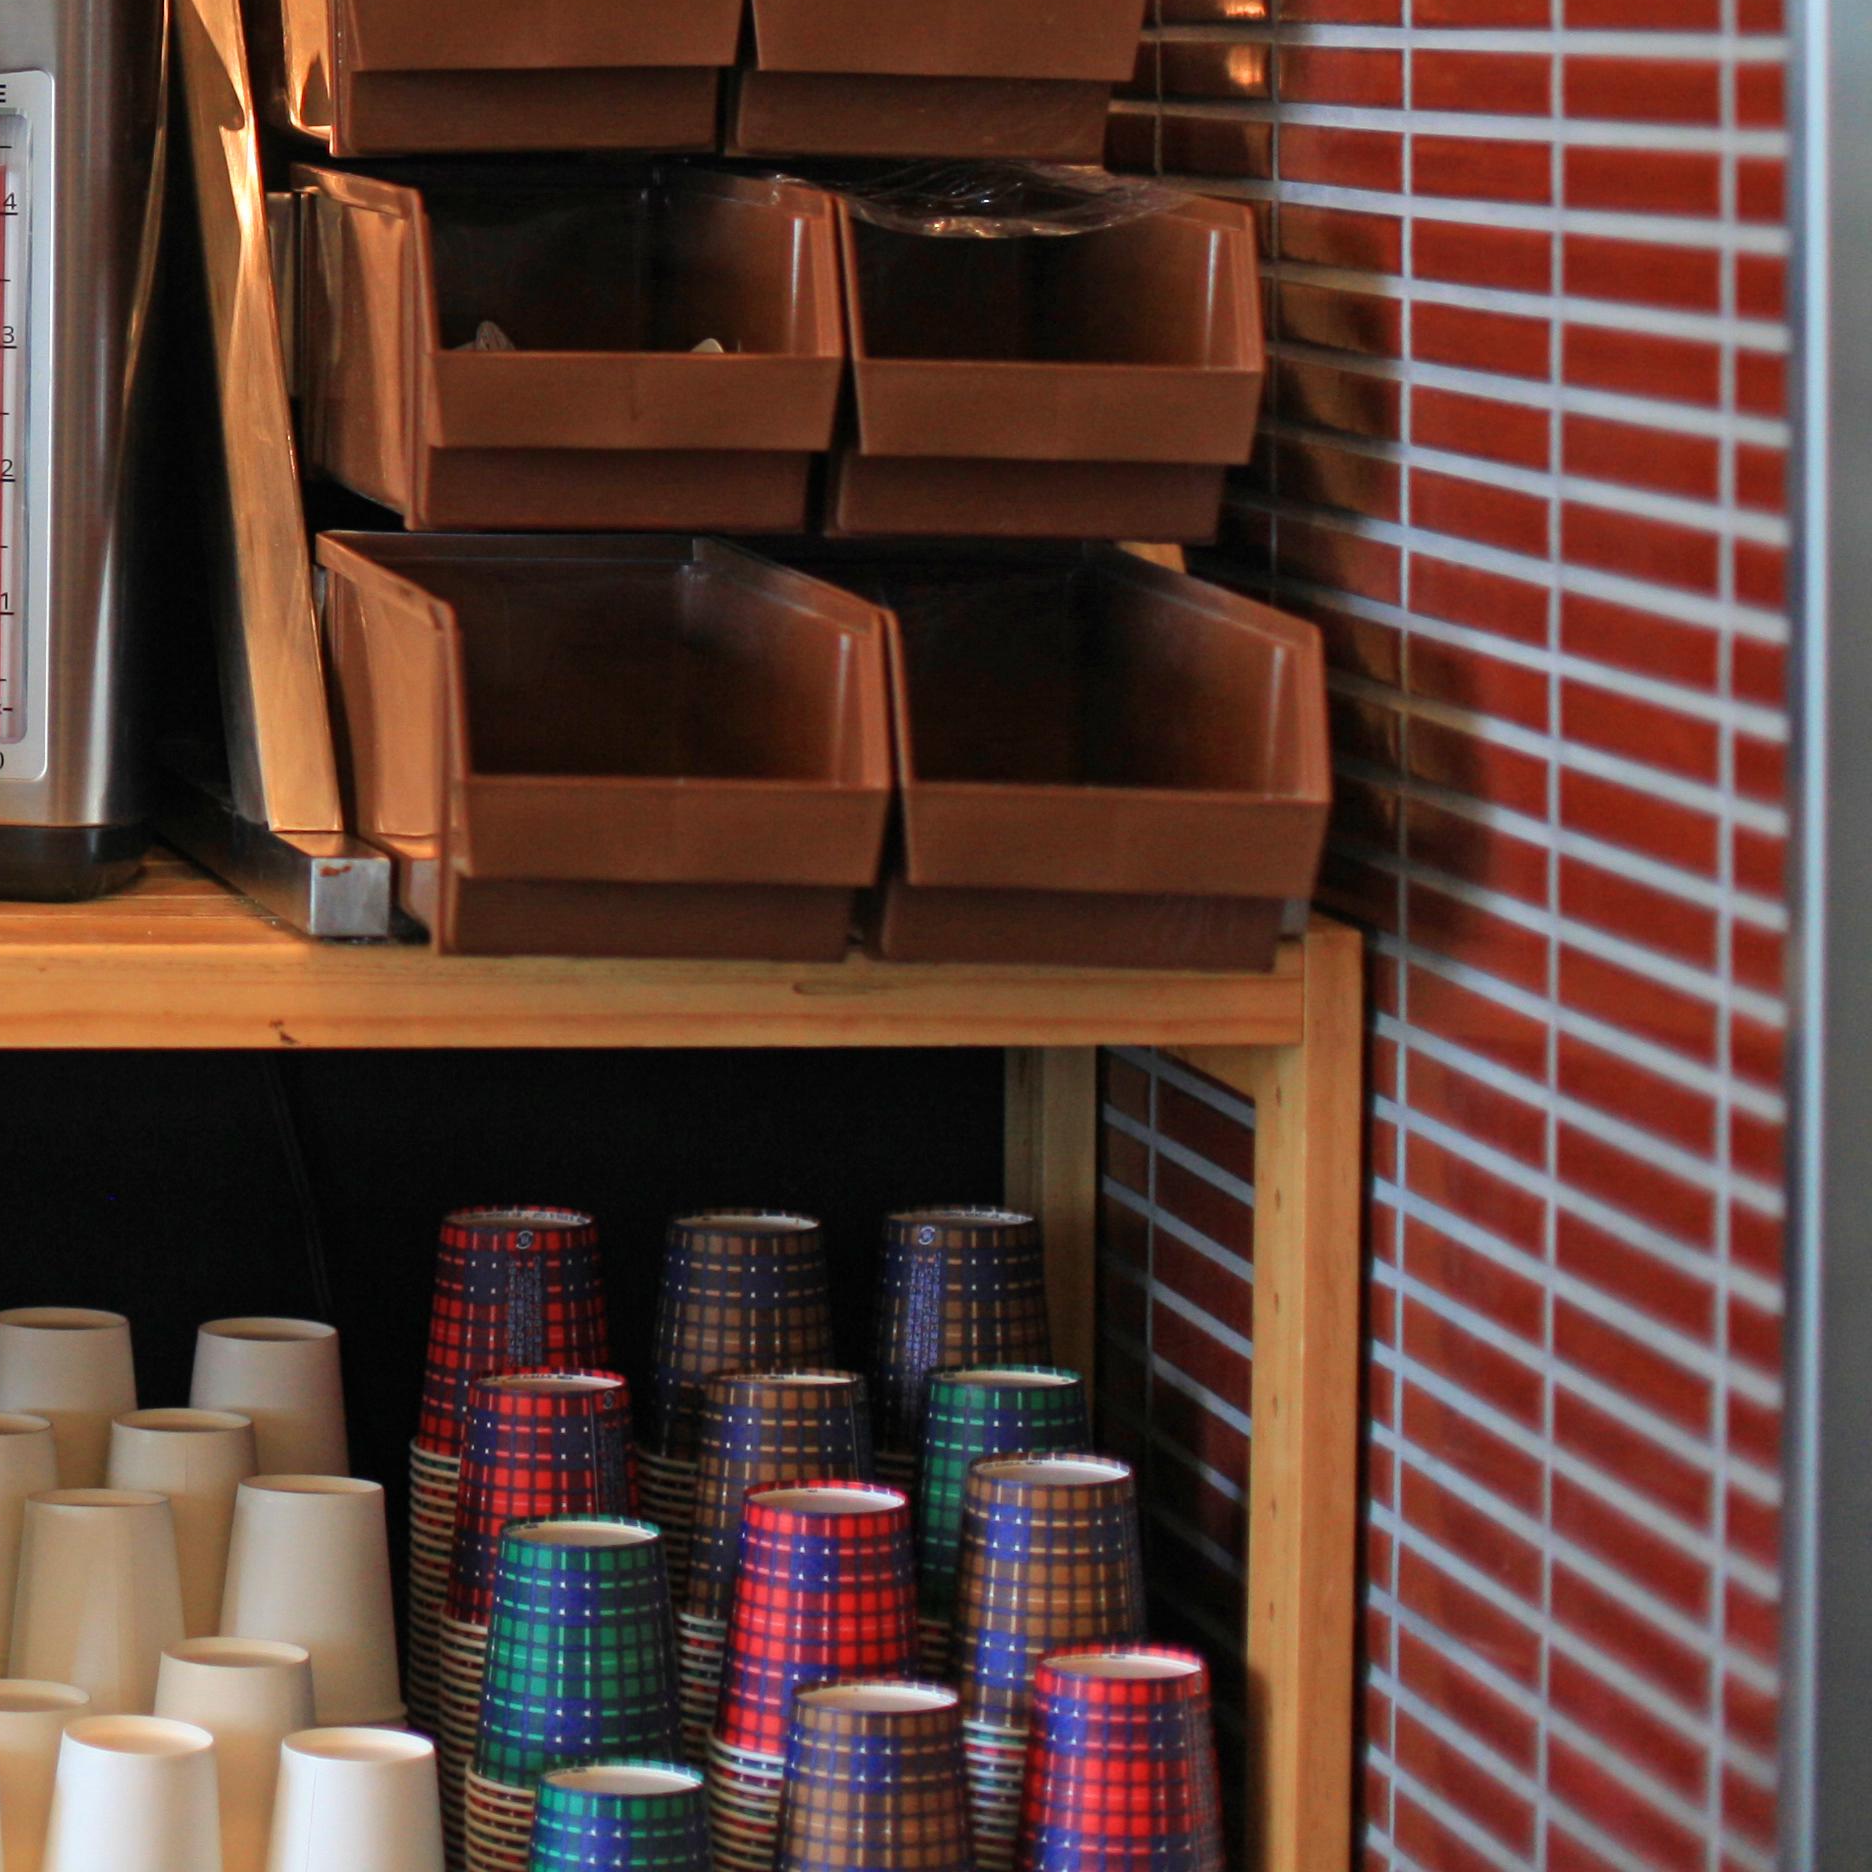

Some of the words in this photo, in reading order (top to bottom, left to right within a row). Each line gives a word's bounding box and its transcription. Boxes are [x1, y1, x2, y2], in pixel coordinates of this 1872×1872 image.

[2, 191, 17, 210] 4
[1, 325, 15, 344] 3
[0, 459, 13, 477] 2
[0, 592, 9, 610] 1
